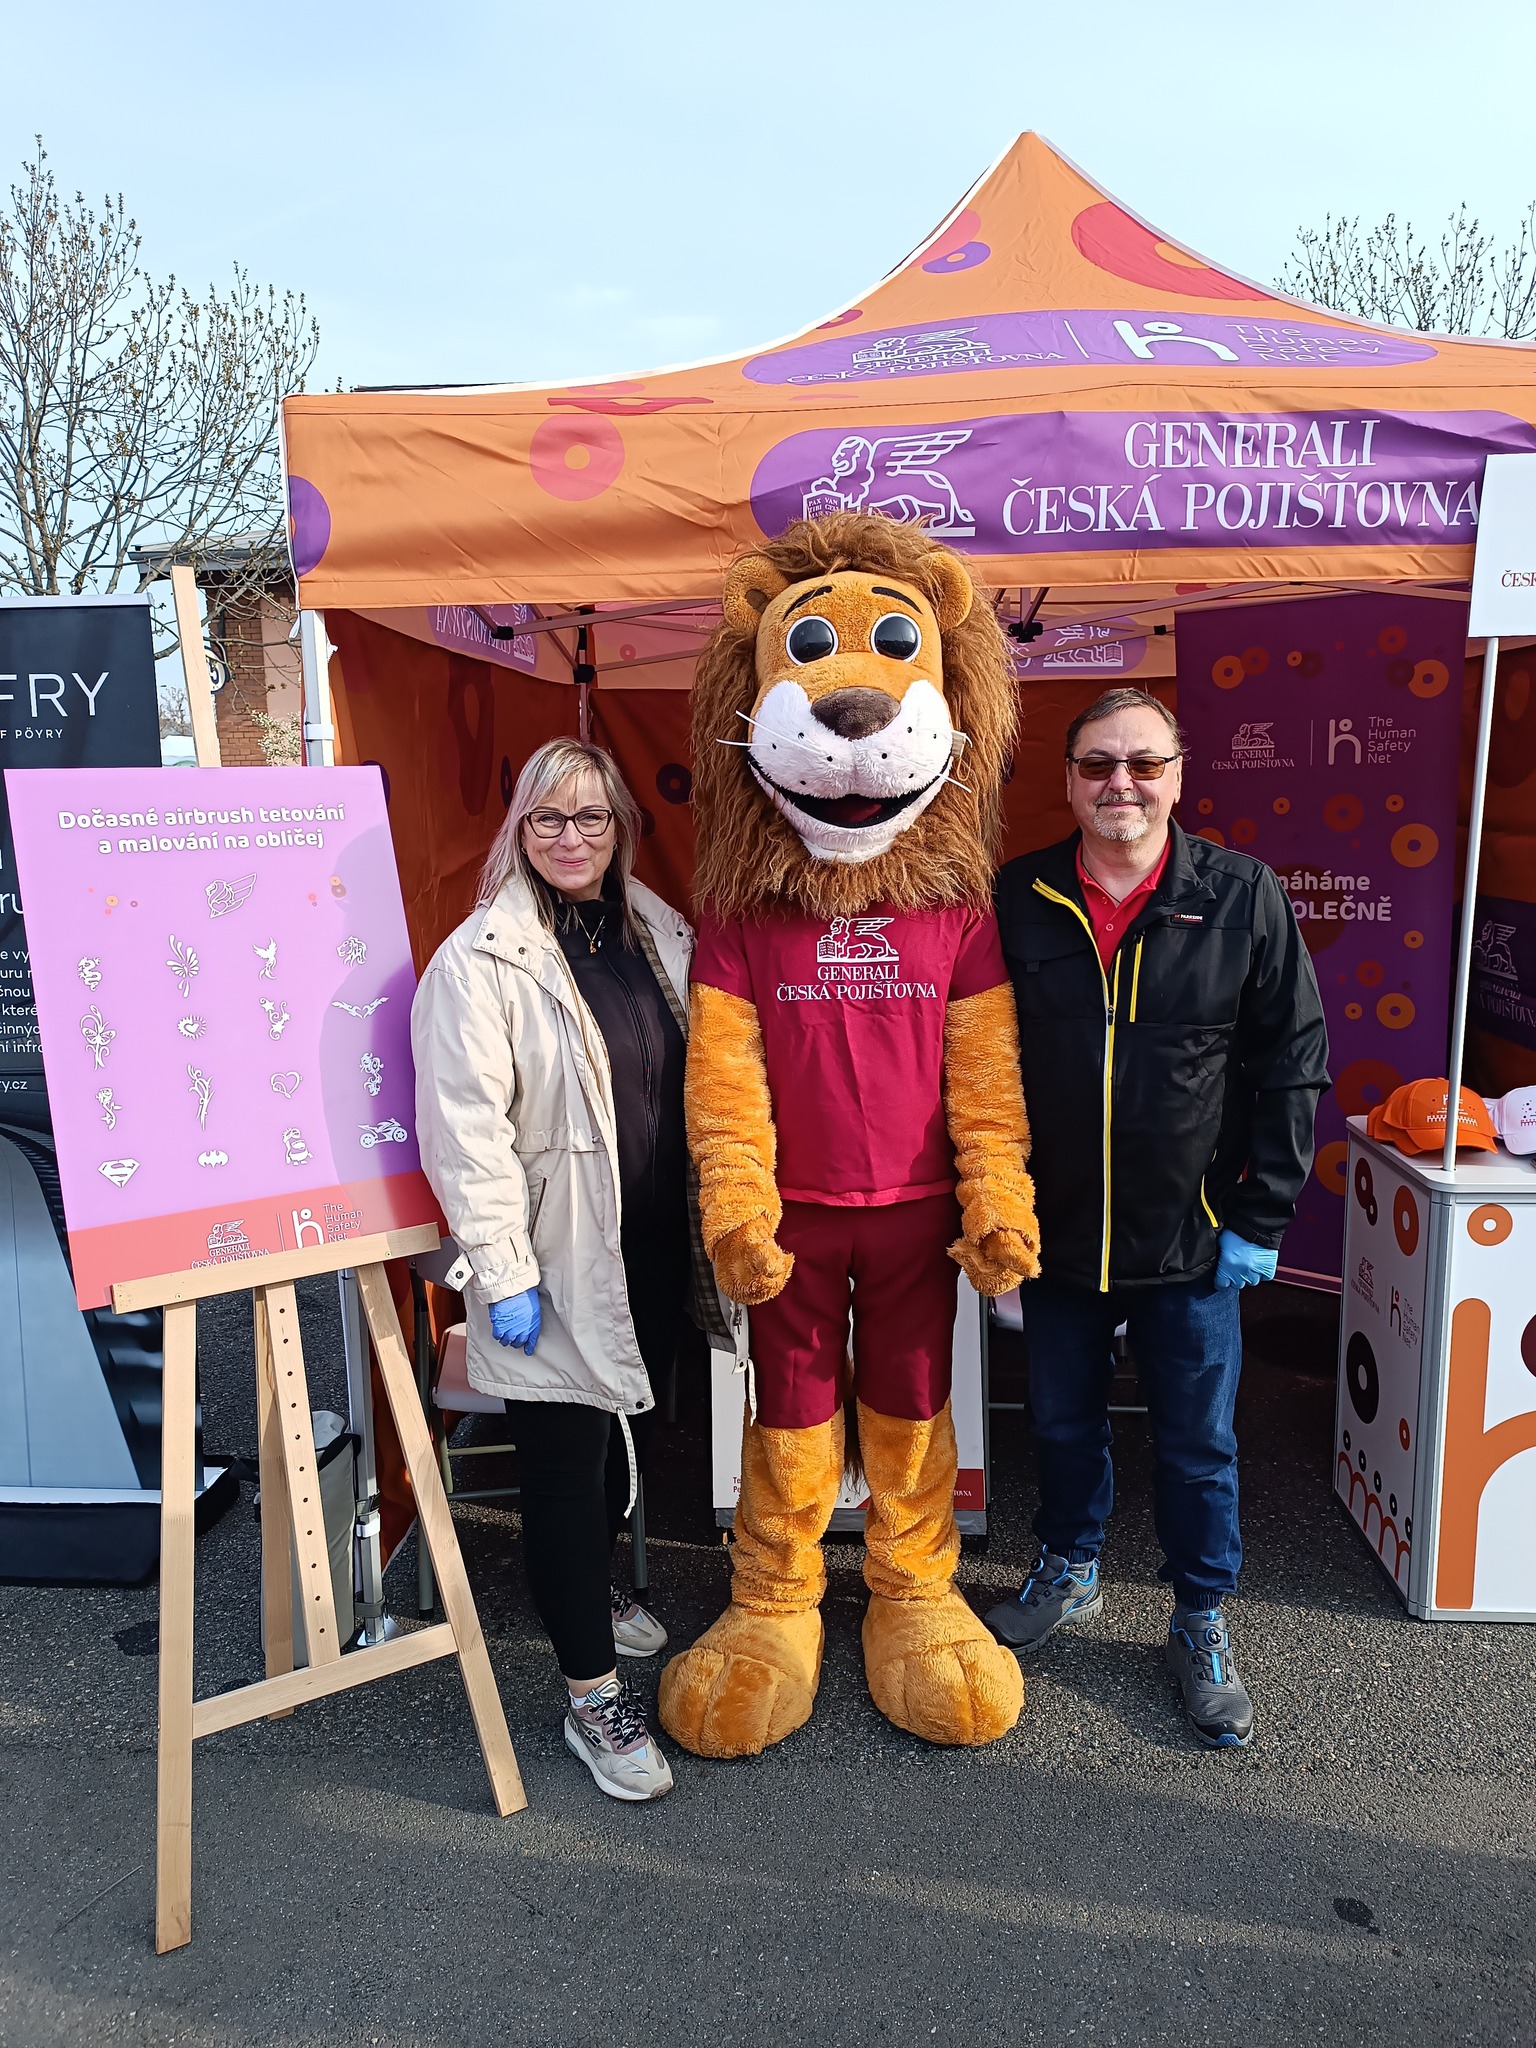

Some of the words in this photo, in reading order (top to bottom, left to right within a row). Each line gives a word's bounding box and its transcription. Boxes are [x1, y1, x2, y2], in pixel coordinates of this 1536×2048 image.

[1225, 323, 1302, 336] The
[1237, 334, 1386, 346] Human
[1248, 343, 1381, 354] Safety
[853, 347, 994, 369] GENERALI
[1258, 353, 1339, 362] Net
[1124, 418, 1381, 469] GENERALI
[1002, 473, 1166, 536] ČESKÁ
[1180, 471, 1478, 531] POJIŠŤOVNA
[1368, 716, 1394, 727] The
[15, 727, 63, 739] PÖYRY
[1368, 728, 1417, 739] Human
[1367, 740, 1411, 753] Safety
[1231, 749, 1275, 760] GENERALI
[1367, 752, 1391, 764] Net
[1212, 759, 1239, 771] ČESKÁ
[1241, 758, 1295, 769] POJIŠŤOVNA
[58, 807, 159, 829] Dočasné
[164, 806, 255, 826] airbrush
[258, 802, 346, 824] tetování
[98, 838, 113, 854] a
[118, 831, 220, 853] malování
[224, 833, 250, 849] na
[255, 827, 325, 849] obličej
[1292, 894, 1392, 921] OLEČNĚ
[817, 964, 900, 981] GENERALI
[776, 982, 831, 1001] ČESKÁ
[836, 980, 938, 1000] POJIŠŤOVNA
[0, 1080, 28, 1093] y.cz
[323, 1203, 344, 1213] The
[325, 1209, 364, 1224] Human
[326, 1219, 362, 1233] Safety
[327, 1231, 348, 1243] Net
[209, 1242, 250, 1258] GENERALI
